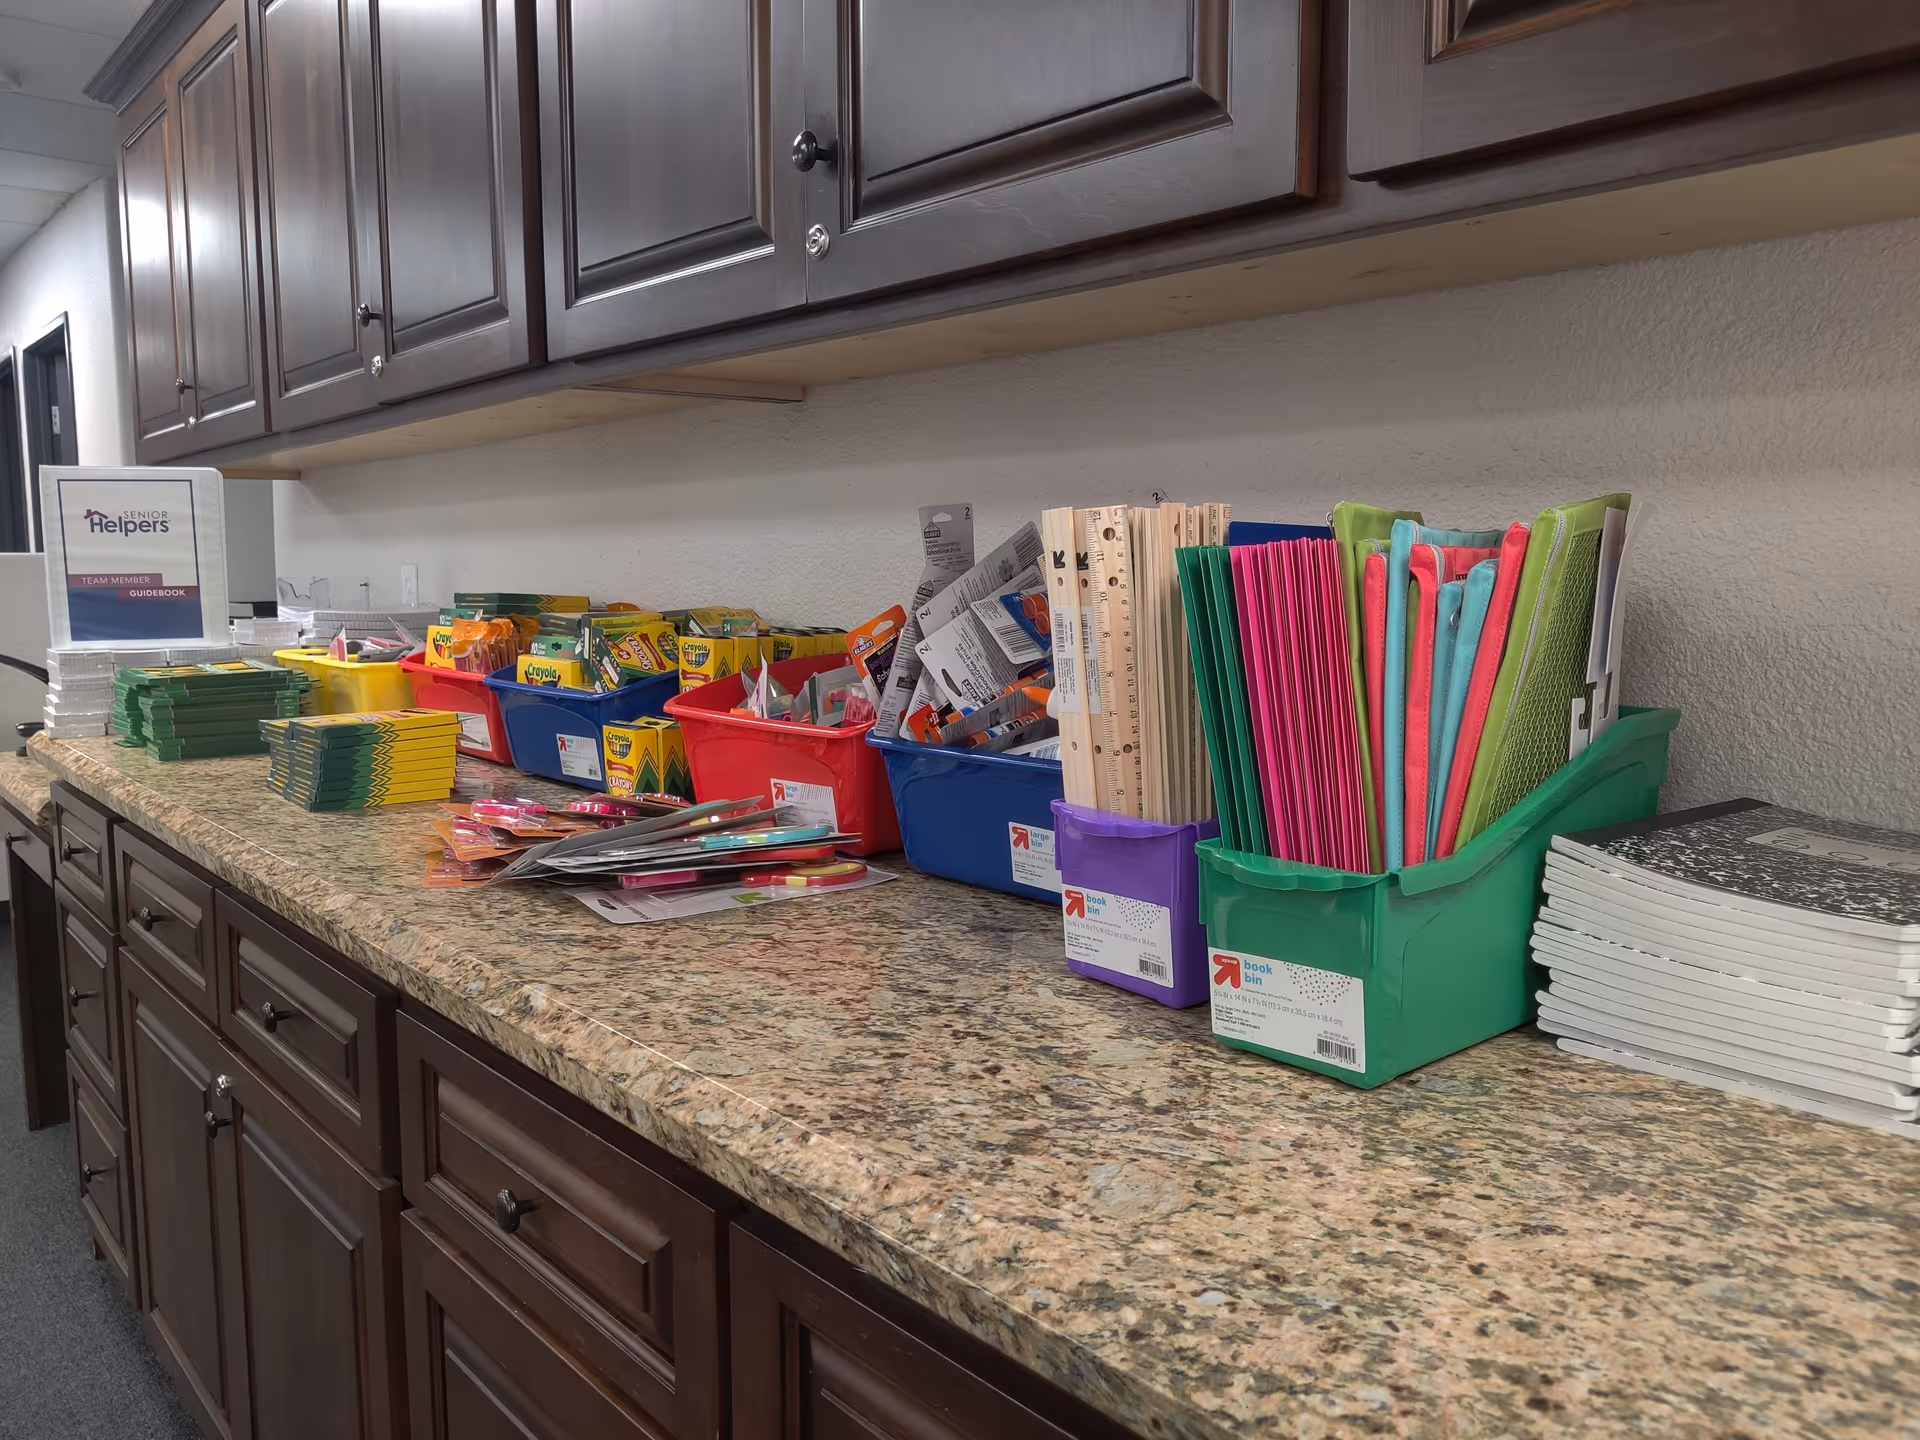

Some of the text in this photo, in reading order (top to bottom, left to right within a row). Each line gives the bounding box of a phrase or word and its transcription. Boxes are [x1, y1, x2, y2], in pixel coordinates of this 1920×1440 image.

[124, 511, 168, 519] SENIOR
[964, 507, 970, 516] 2
[1093, 511, 1101, 520] 12
[90, 516, 169, 537] Helpers
[1097, 552, 1104, 562] 11
[82, 576, 151, 585] TEAM MEMBER
[129, 589, 186, 597] GUIDEBOOK
[1100, 592, 1107, 602] 10
[920, 609, 928, 619] 2
[724, 623, 731, 632] 24
[683, 642, 708, 652] Crayola
[920, 645, 928, 654] 2
[625, 634, 654, 671] CRAYONS
[527, 663, 557, 680] Crayola
[1126, 662, 1133, 672] 10
[1127, 678, 1134, 687] 11
[1129, 694, 1136, 703] 12
[1130, 709, 1137, 719] 13
[1131, 725, 1138, 734] 14
[608, 732, 630, 743] Crayola
[1133, 740, 1140, 750] 15
[1134, 756, 1141, 766] 16
[609, 775, 632, 792] CRAYONS
[1030, 830, 1049, 841] large
[1031, 839, 1042, 848] bin
[1086, 894, 1107, 906] book
[1087, 905, 1100, 915] bin
[1244, 959, 1273, 974] book
[1244, 973, 1263, 985] bin
[1295, 1008, 1307, 1017] 35.5
[1308, 1011, 1316, 1019] cm
